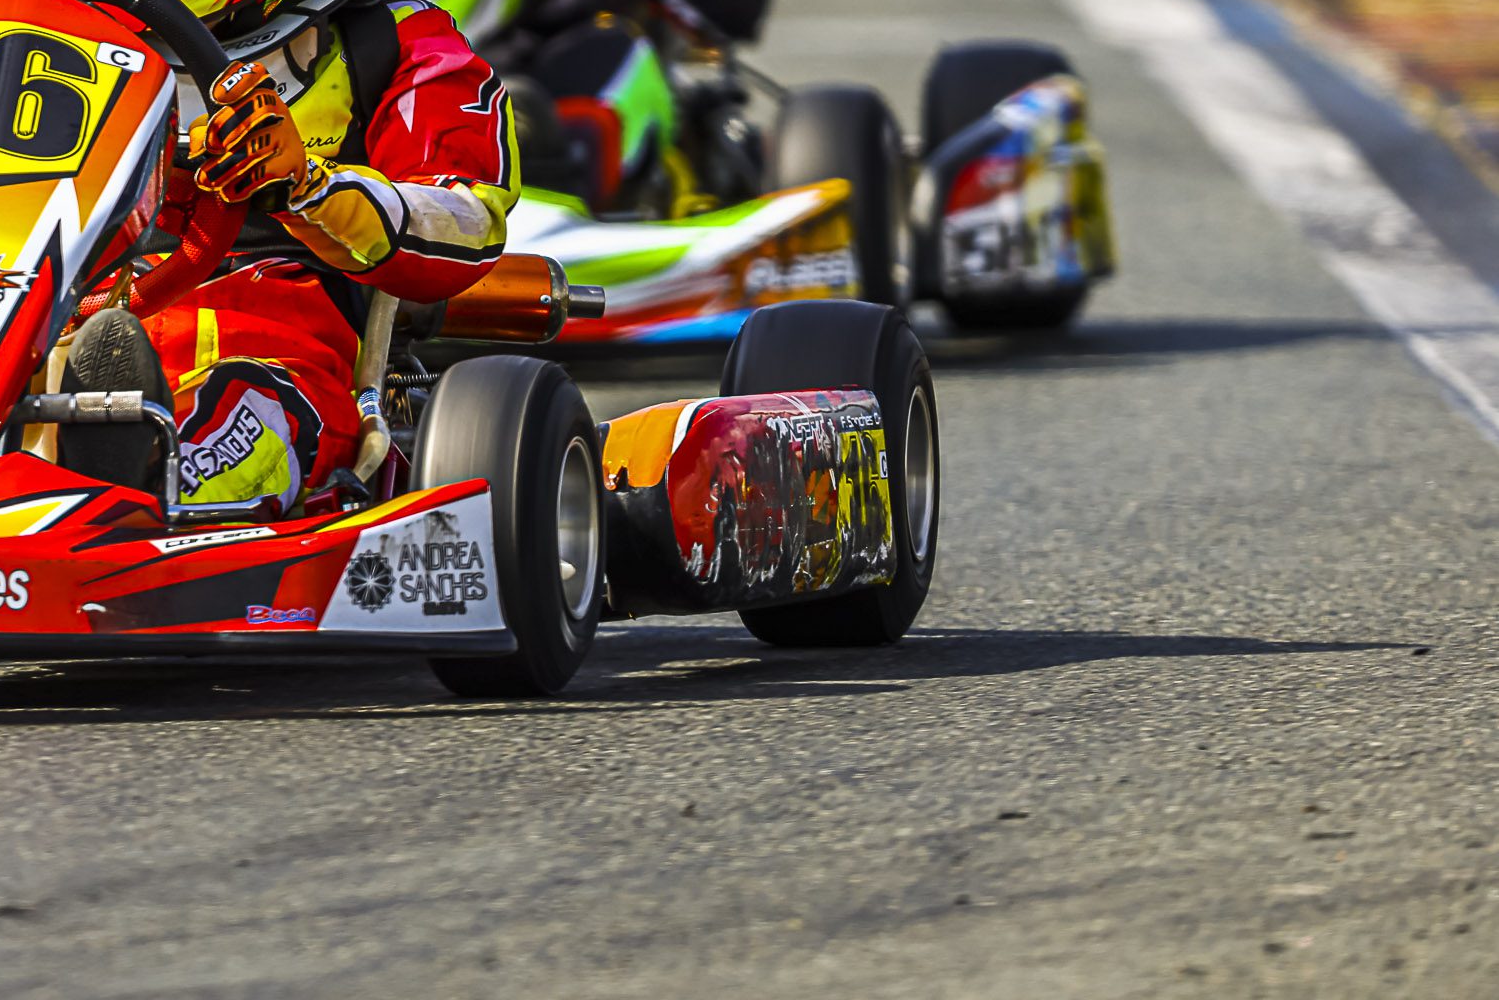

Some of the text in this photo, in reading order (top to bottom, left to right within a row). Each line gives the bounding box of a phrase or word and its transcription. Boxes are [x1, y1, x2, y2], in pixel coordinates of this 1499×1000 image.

[109, 49, 131, 66] C
[397, 541, 485, 572] ANDREA
[399, 572, 488, 602] SANCHES
